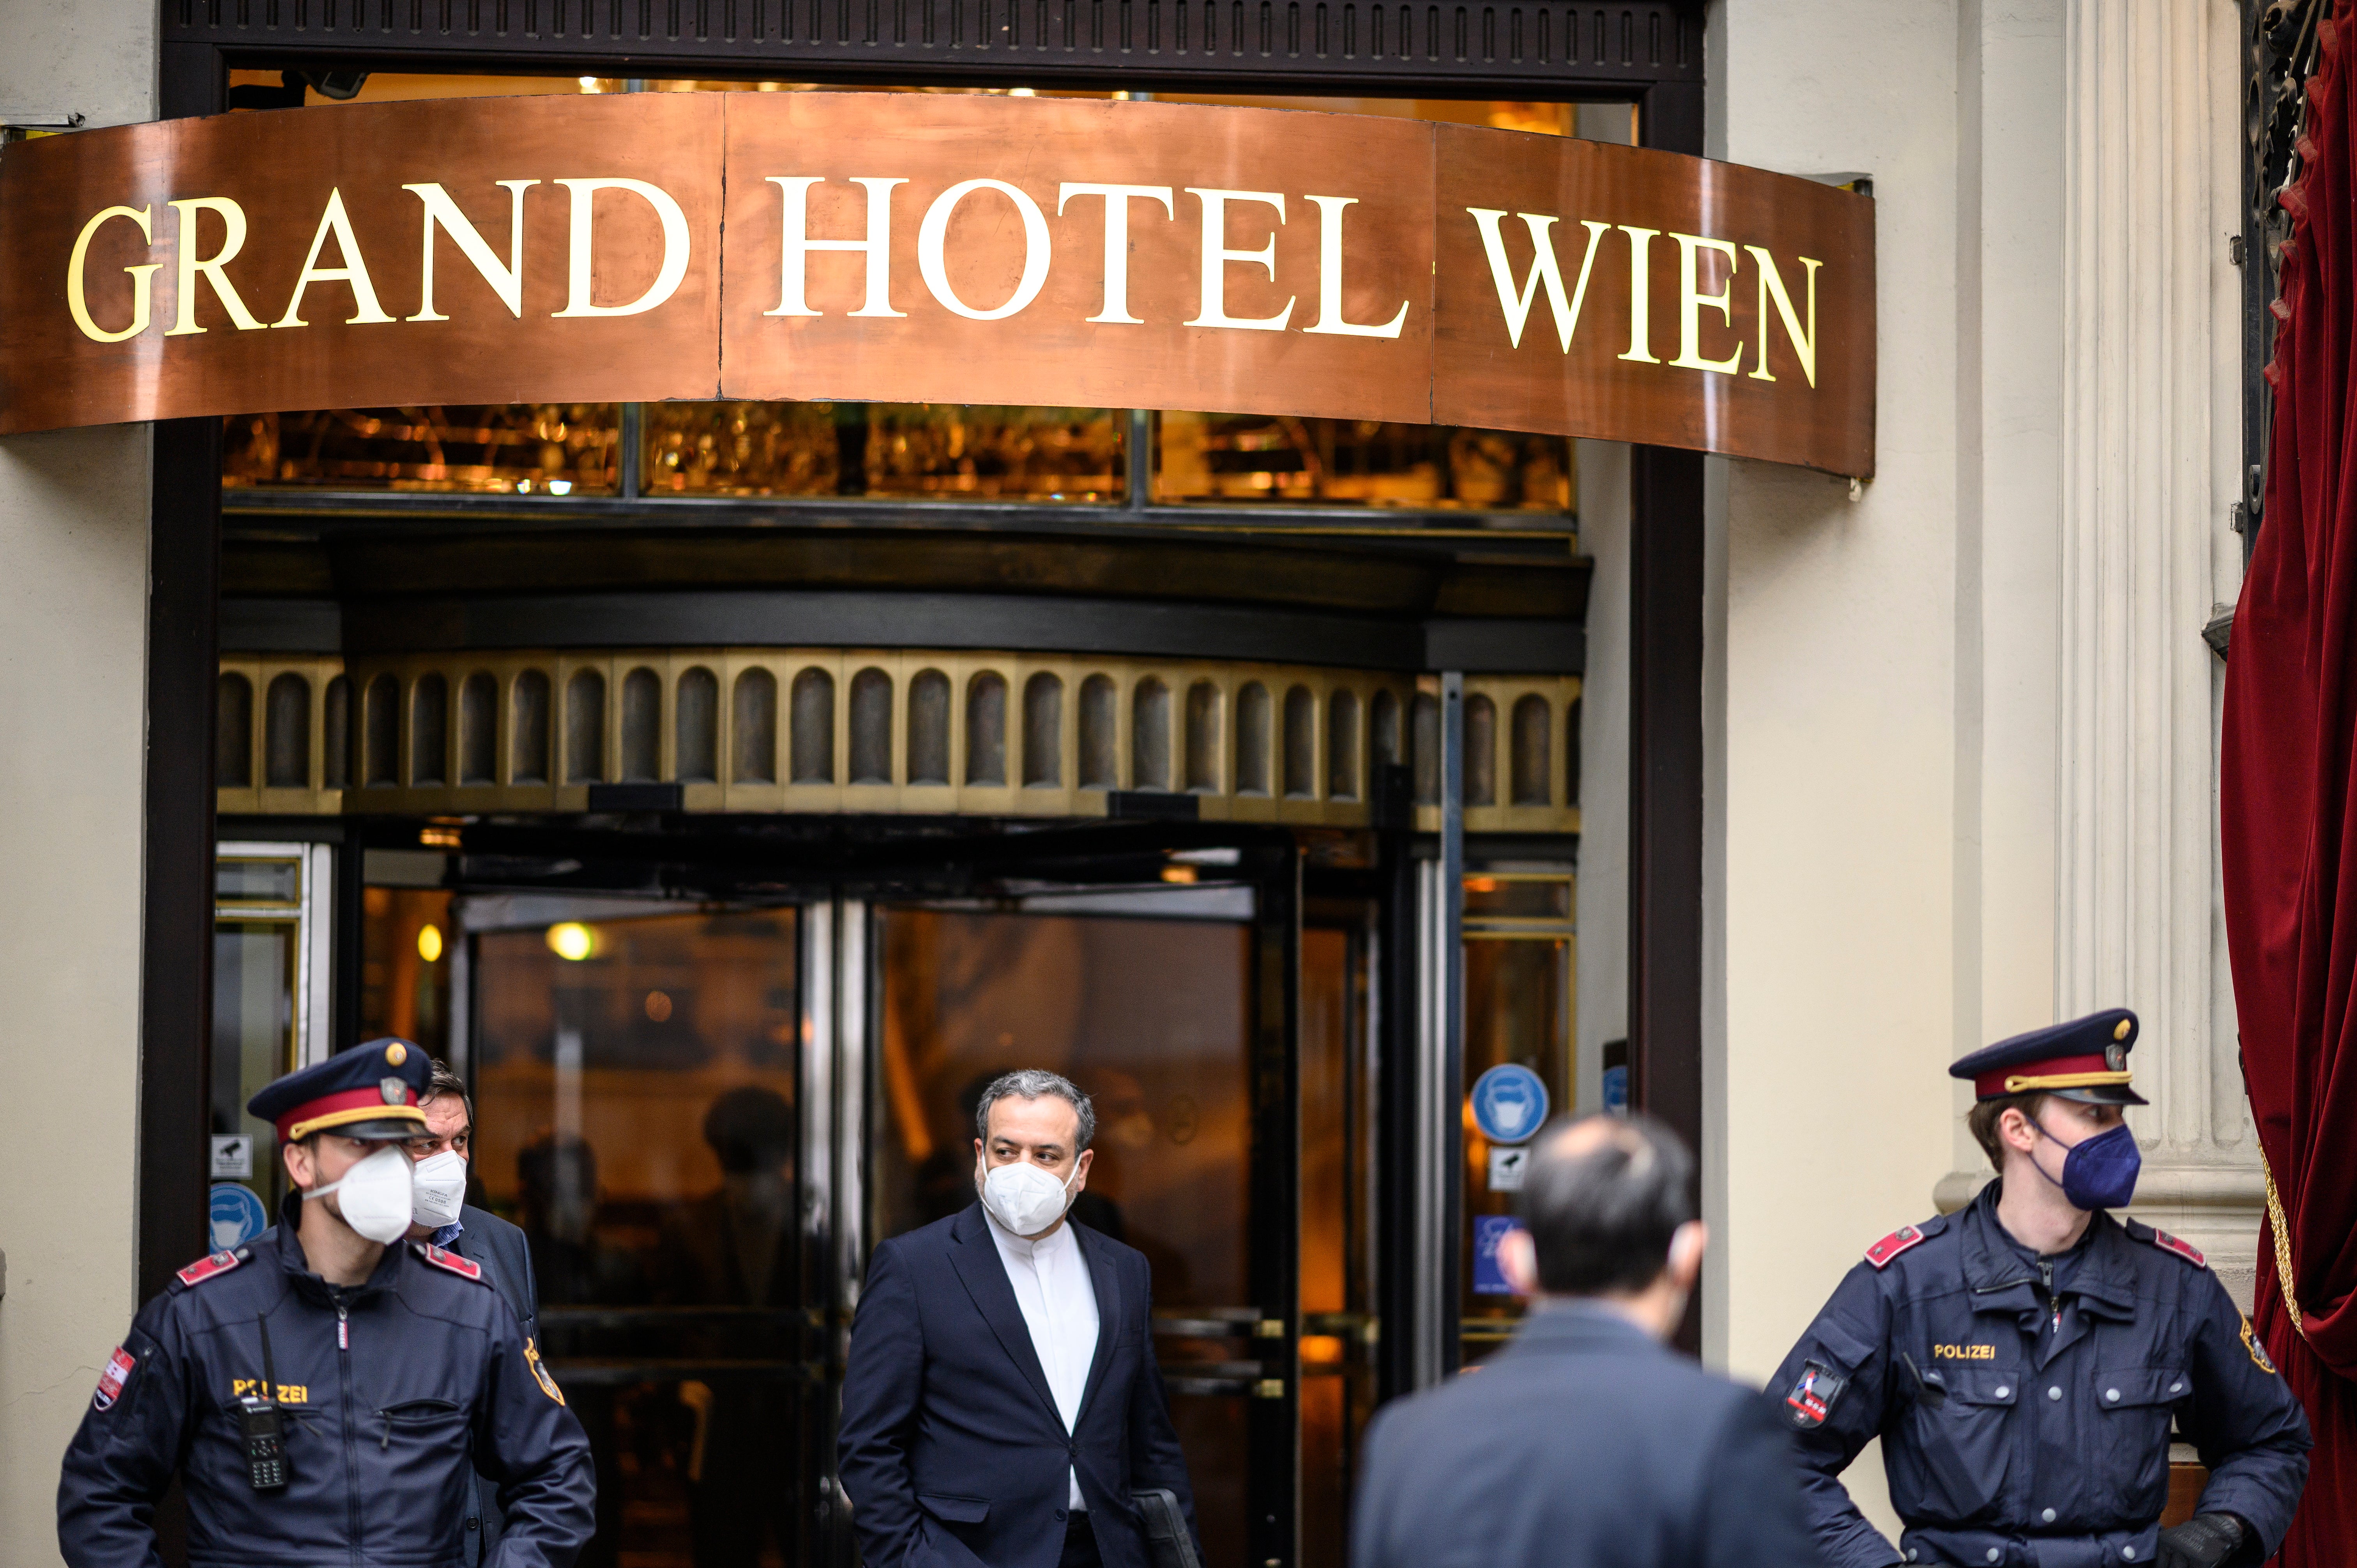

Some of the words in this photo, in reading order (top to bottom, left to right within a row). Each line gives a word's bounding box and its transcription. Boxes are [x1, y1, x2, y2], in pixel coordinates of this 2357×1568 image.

[67, 177, 691, 343] GRAND
[763, 176, 1410, 339] HOTEL
[1466, 207, 1823, 389] WIEN
[1934, 1344, 1995, 1360] POLIZEI
[233, 1379, 307, 1403] PZEI
